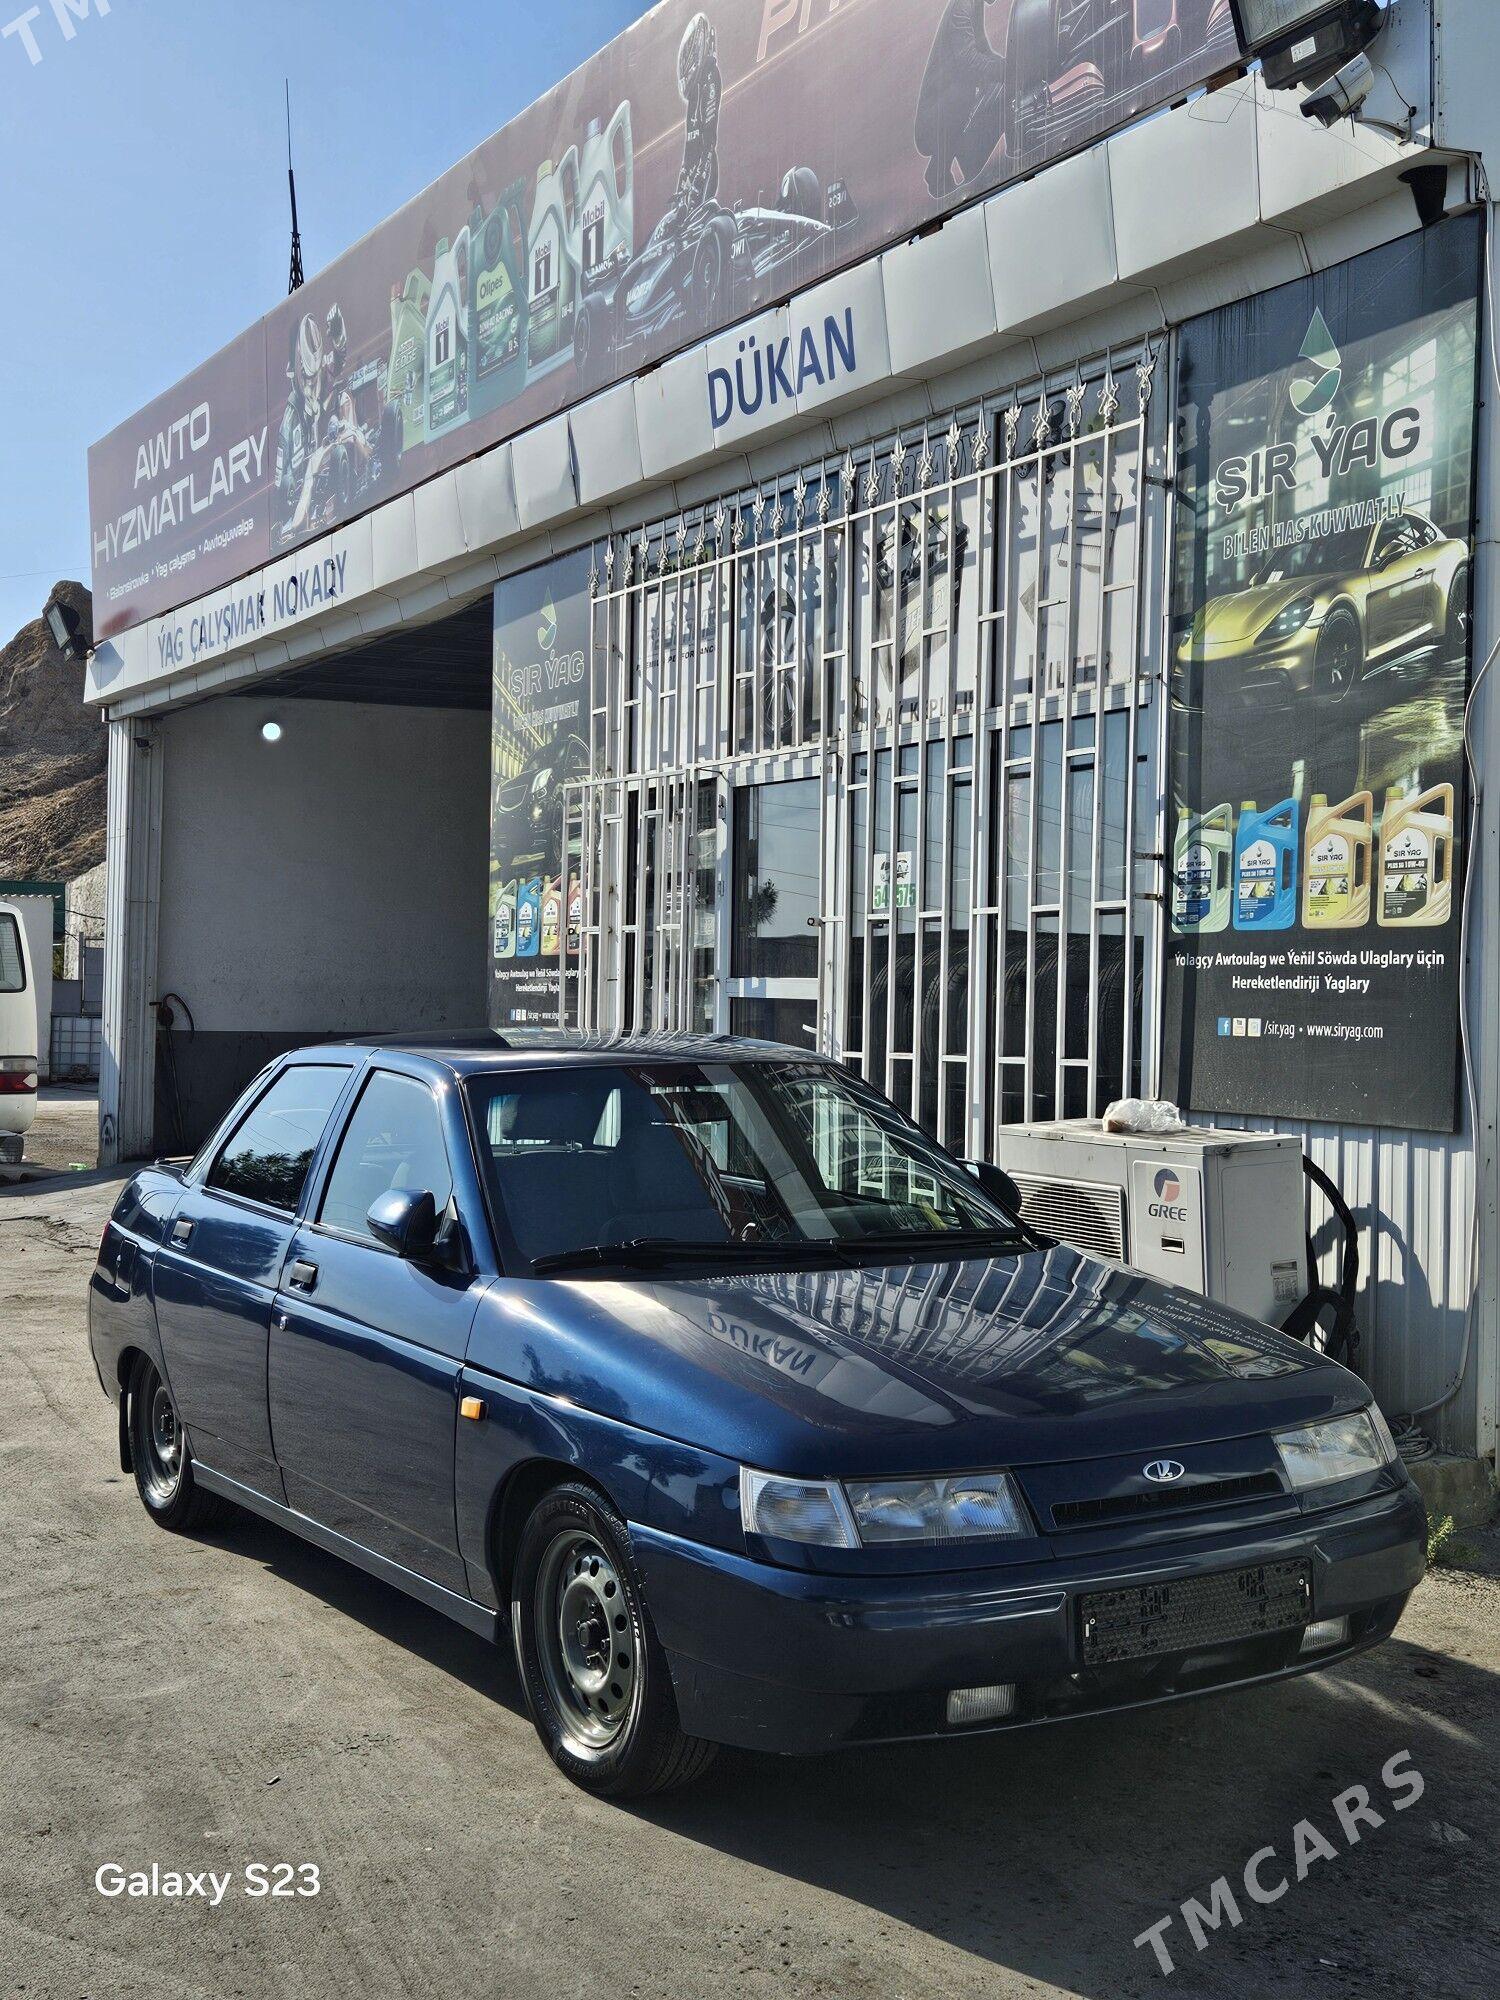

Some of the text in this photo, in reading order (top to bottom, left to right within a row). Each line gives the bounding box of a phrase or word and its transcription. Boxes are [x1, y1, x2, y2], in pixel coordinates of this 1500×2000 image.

[708, 306, 856, 430] DÜKAN
[134, 401, 210, 489] AWTO
[1215, 406, 1421, 514] ŞIR ÝAG
[94, 426, 268, 569] HYZMATLARY
[1223, 525, 1270, 560] BILEN
[1272, 519, 1305, 548] HAS
[158, 624, 183, 669] ÝAG
[273, 550, 347, 622] NOKADY
[544, 649, 585, 690] ÝAG
[1215, 951, 1267, 969] Awtoulag
[1269, 956, 1286, 965] we
[1287, 949, 1315, 965] Ýeňil
[1317, 950, 1358, 965] Söwda
[1360, 949, 1414, 969] Ulaglary
[1416, 950, 1445, 969] üçin
[1232, 973, 1370, 994] Hereketlendiriji Ýaglary
[1306, 1022, 1384, 1041] www.siryag.com
[1148, 1203, 1188, 1222] GREE
